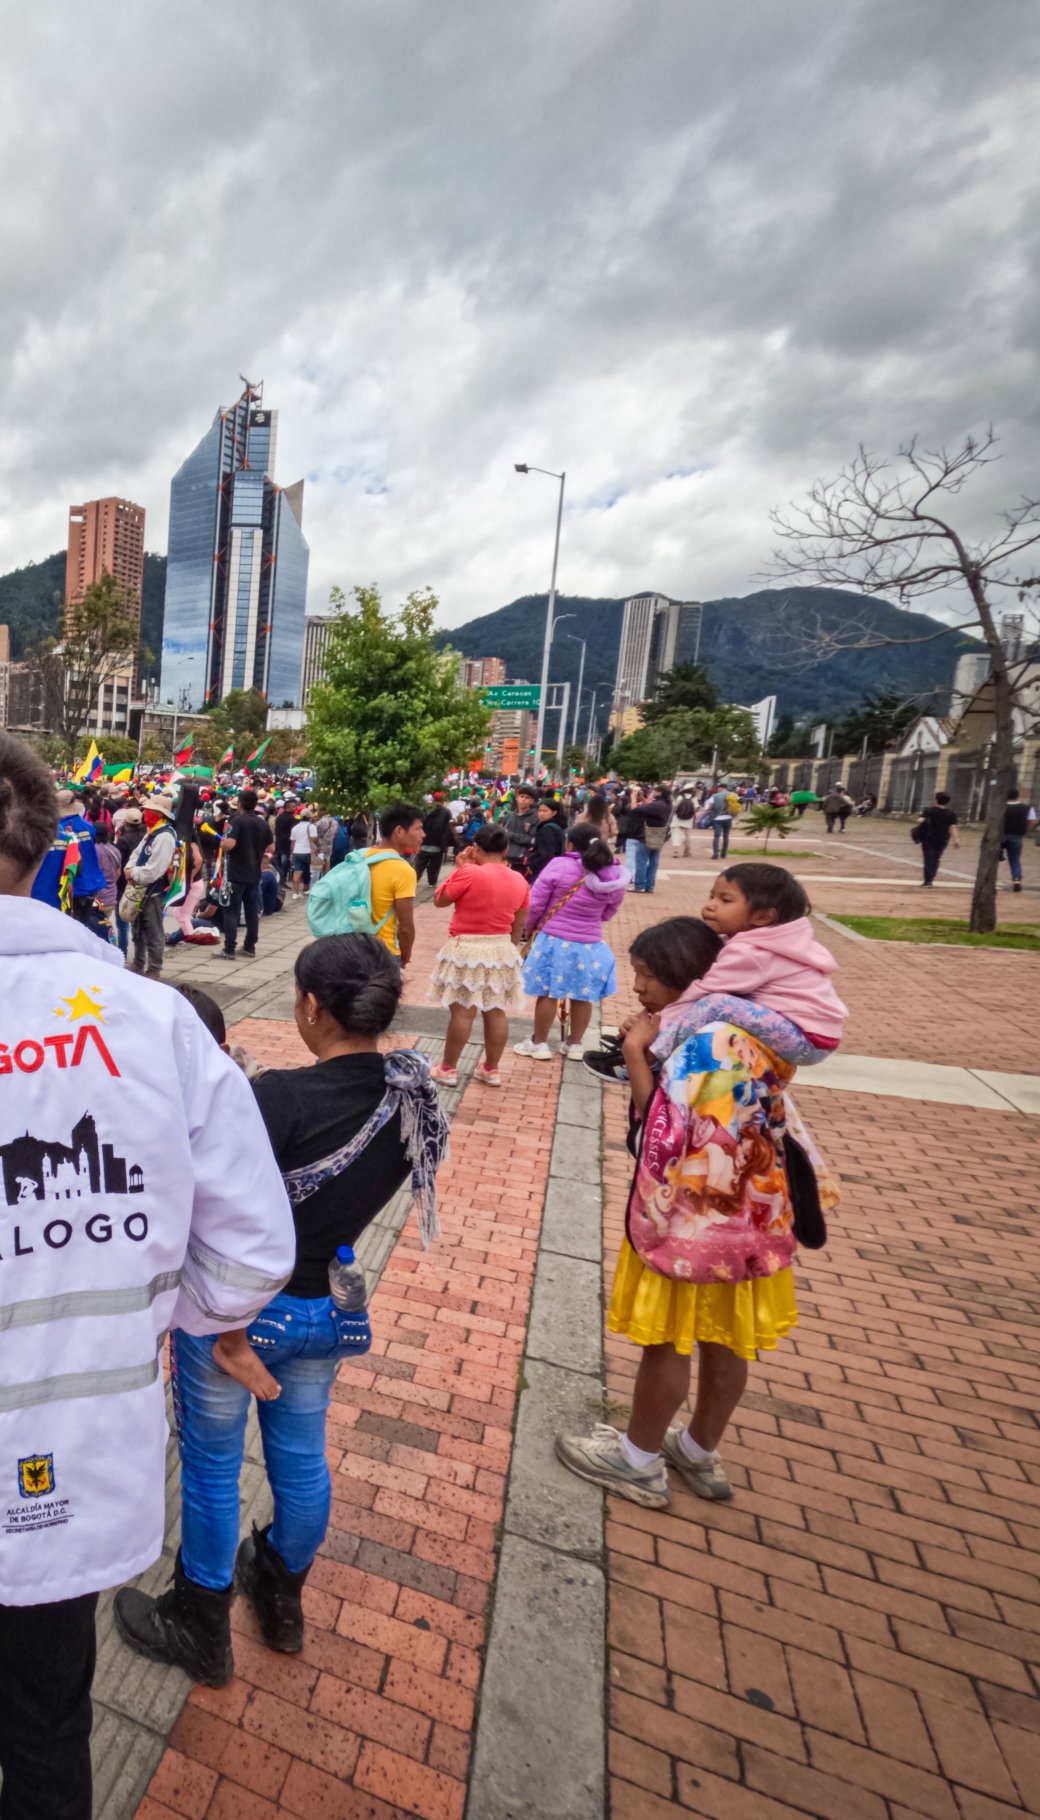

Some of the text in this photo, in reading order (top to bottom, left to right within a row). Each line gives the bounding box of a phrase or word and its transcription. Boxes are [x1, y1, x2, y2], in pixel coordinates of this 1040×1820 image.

[7, 1500, 69, 1515] ALCALDÍA MAYOR
[21, 1509, 51, 1522] BOGOTÁ
